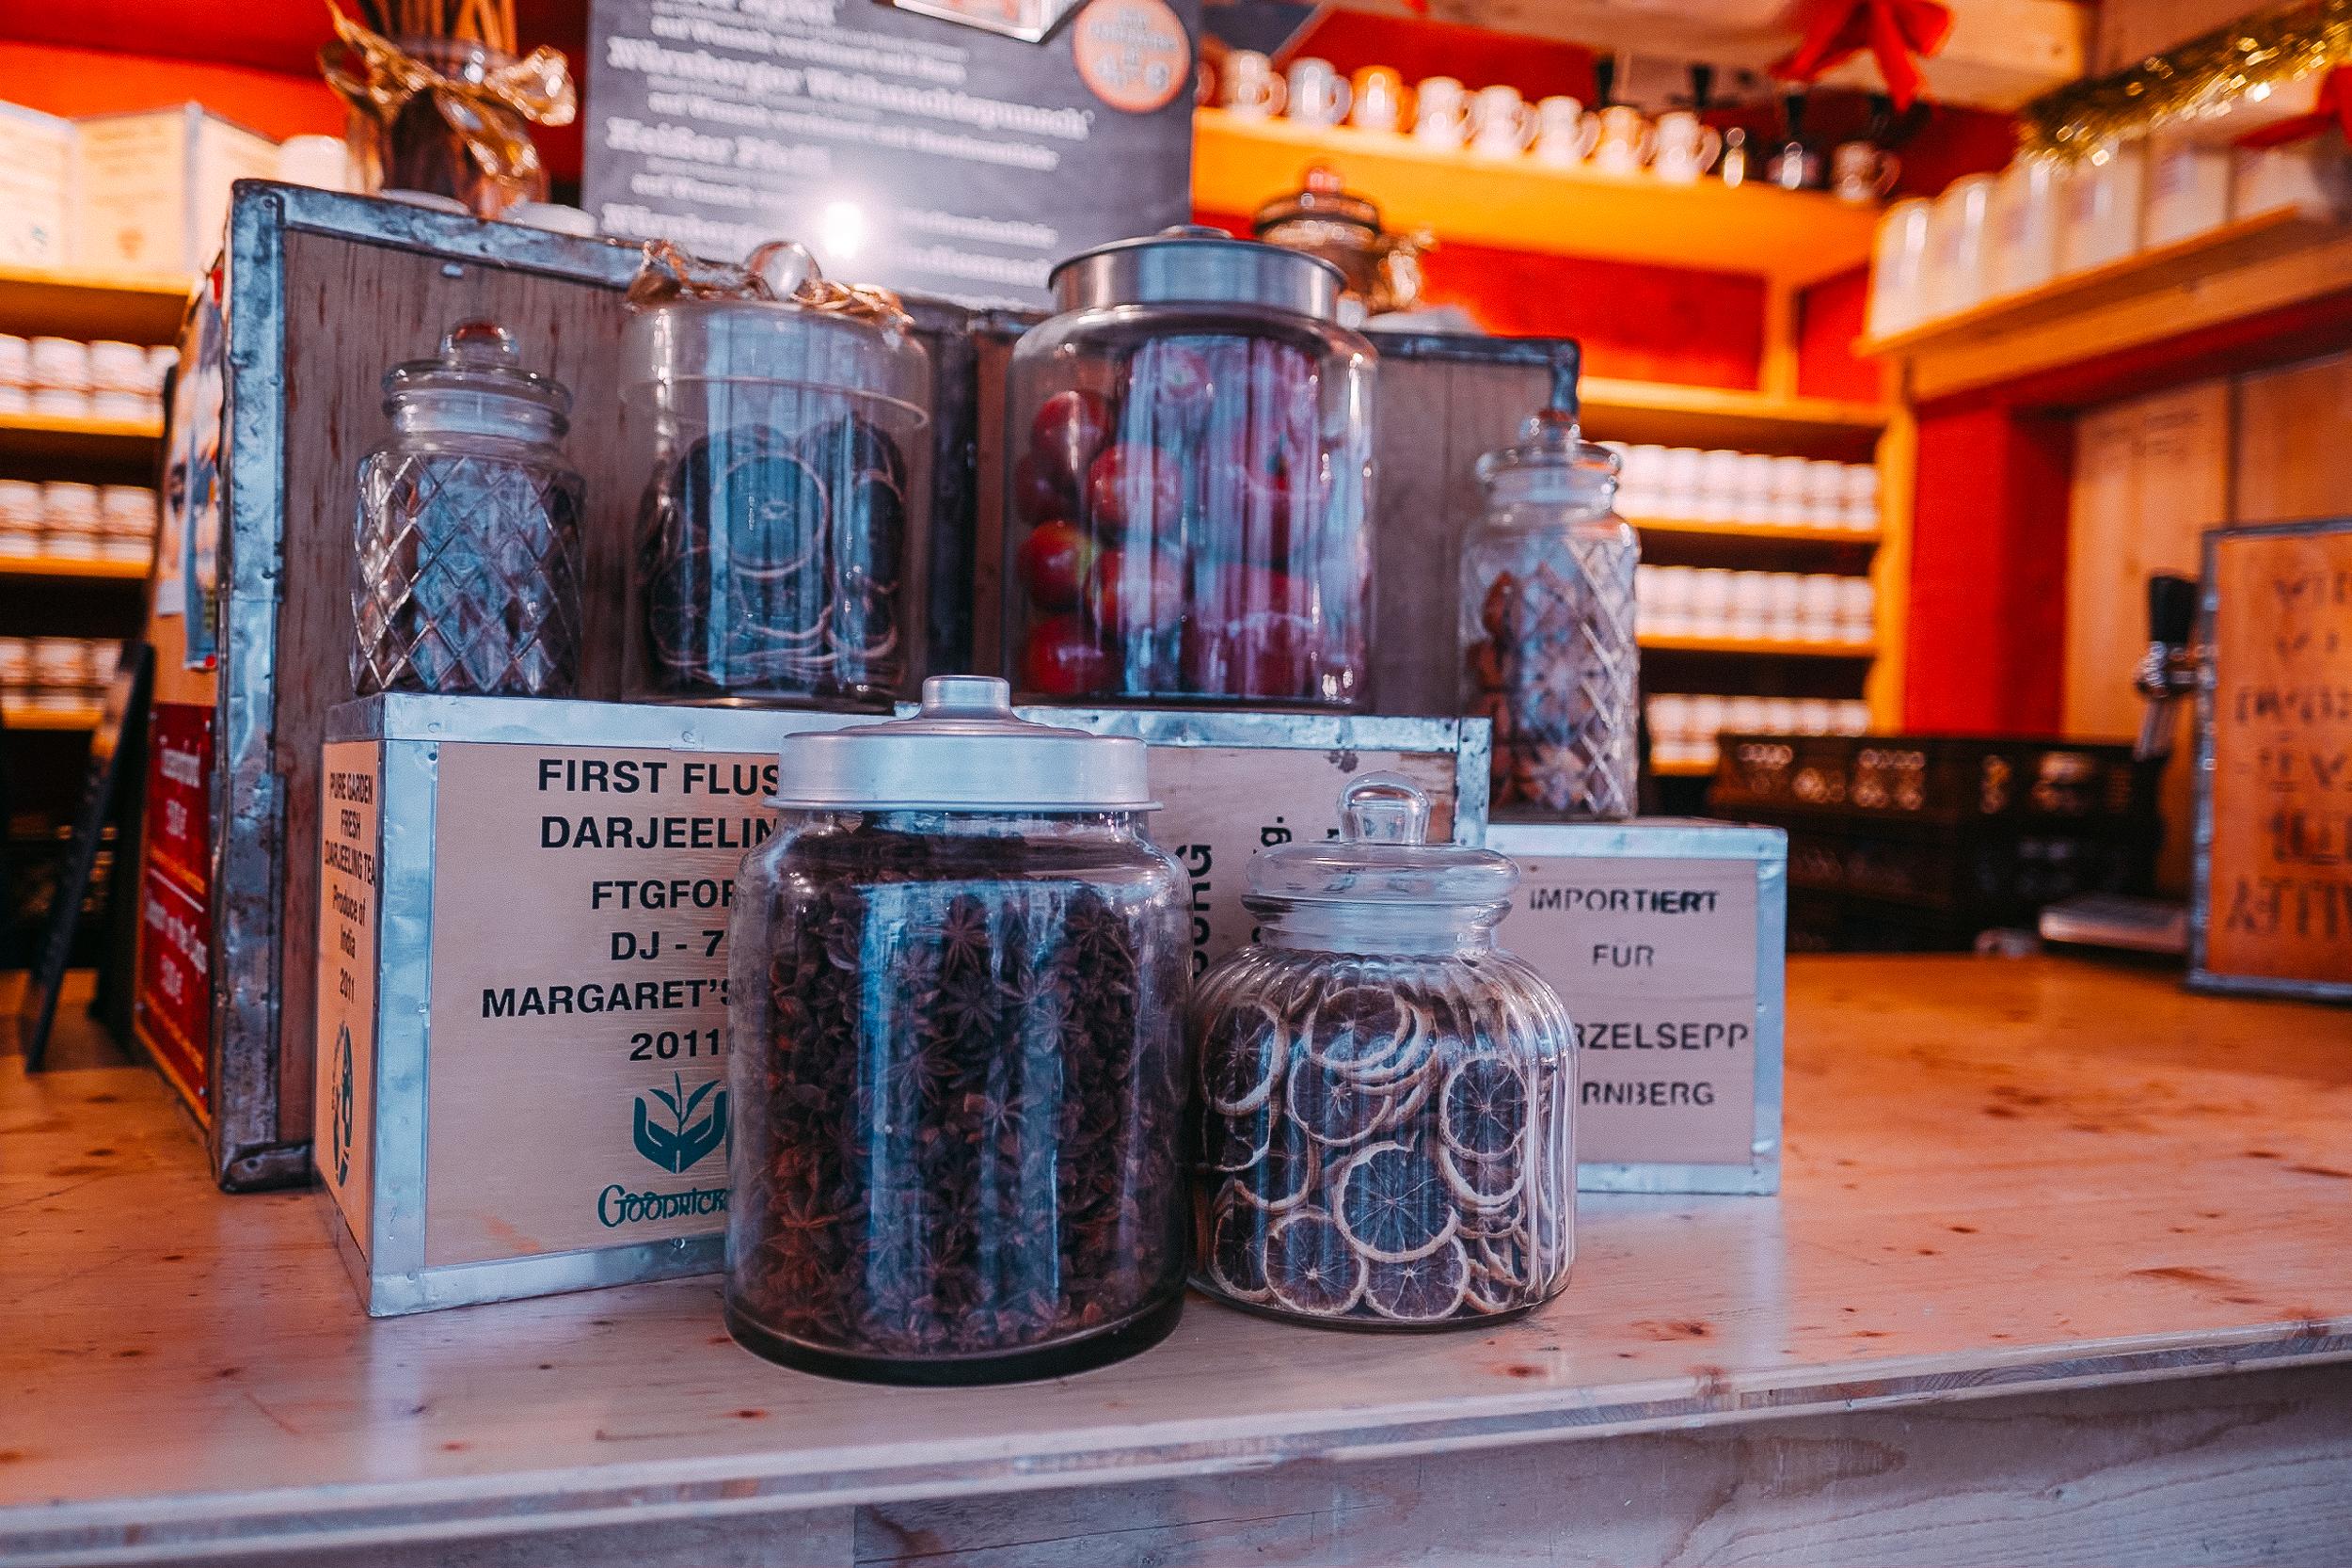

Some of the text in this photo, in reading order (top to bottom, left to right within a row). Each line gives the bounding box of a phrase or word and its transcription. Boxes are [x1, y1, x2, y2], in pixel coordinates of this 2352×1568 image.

[329, 772, 373, 805] PURE GARDEN
[538, 758, 668, 794] FIRST
[340, 808, 361, 842] FRESH
[325, 840, 376, 888] DARJEELING TEA
[333, 884, 366, 927] Produce of
[1530, 888, 1718, 914] IMPORTIERT
[340, 924, 357, 959] India
[611, 930, 660, 960] DJ
[702, 929, 724, 958] 7
[339, 968, 356, 1005] 2011
[629, 1028, 720, 1061] 2011
[1581, 1081, 1715, 1106] RNBERG
